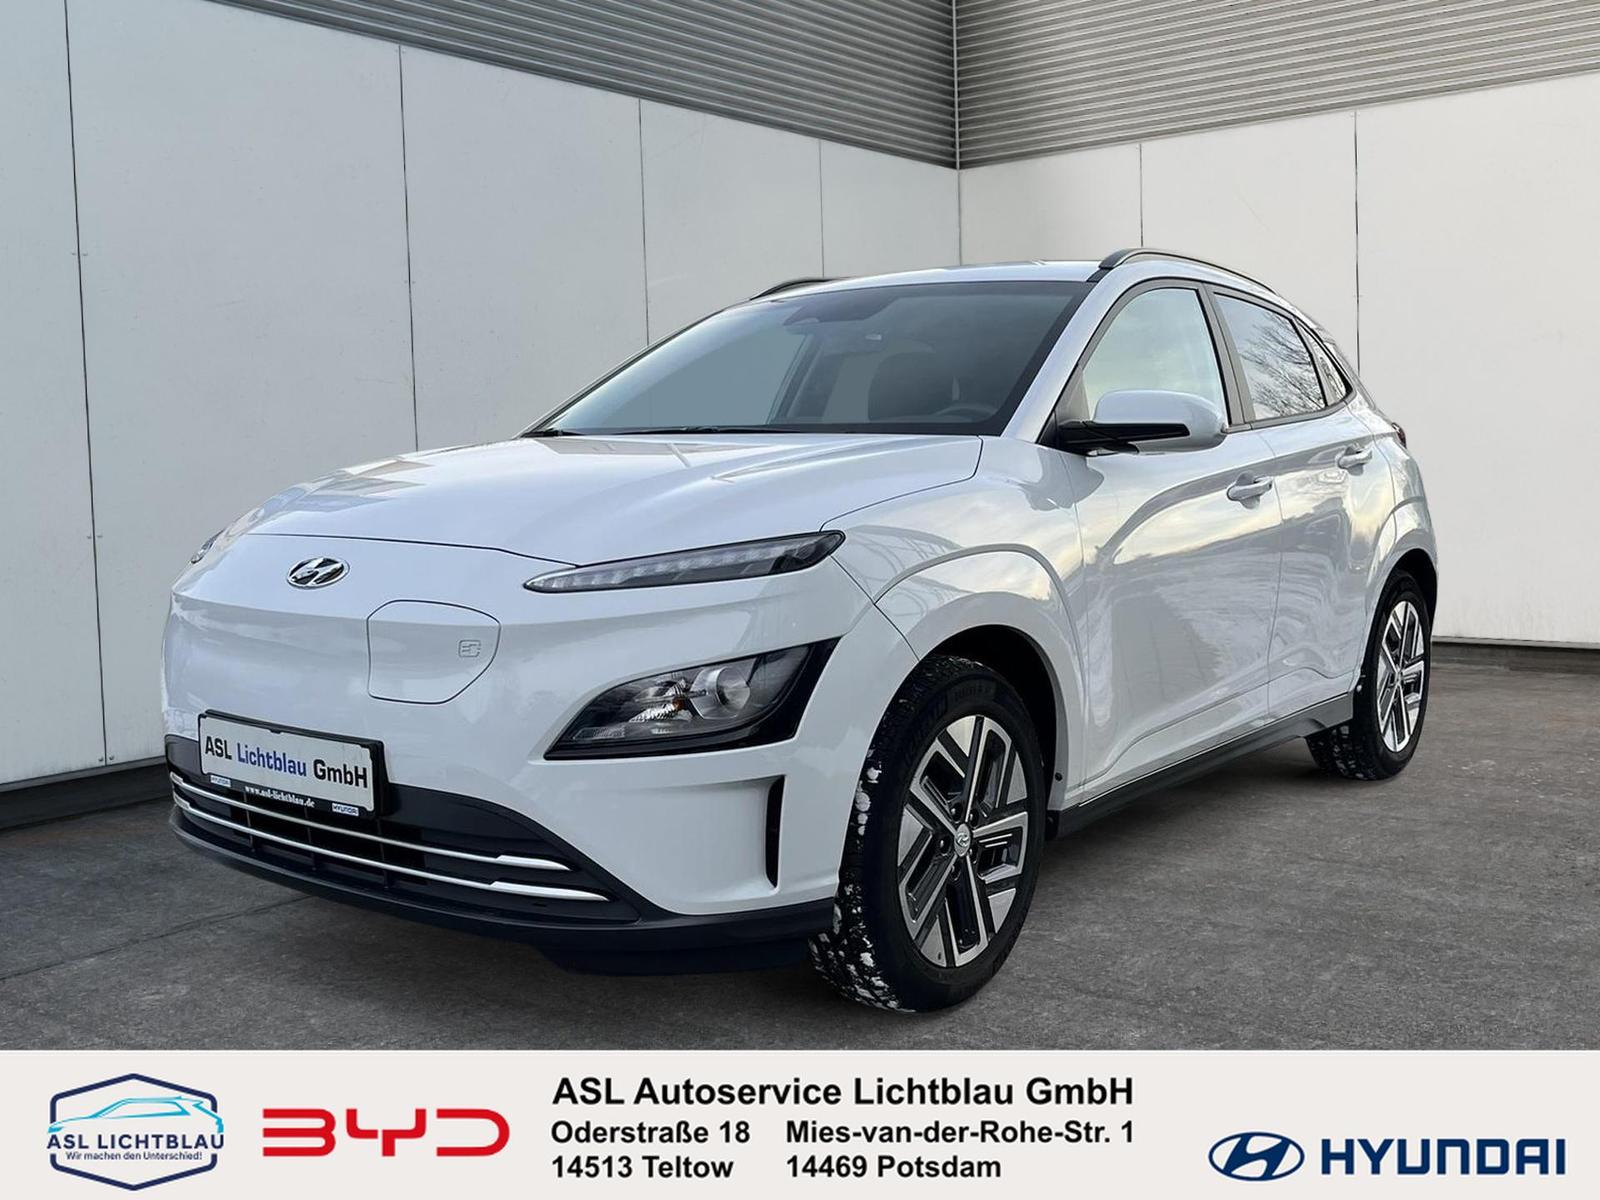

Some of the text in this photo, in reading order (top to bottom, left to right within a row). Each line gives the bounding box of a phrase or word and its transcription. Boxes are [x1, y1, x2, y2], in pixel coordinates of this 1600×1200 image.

[205, 736, 368, 788] ASL Lichtblau GmbH
